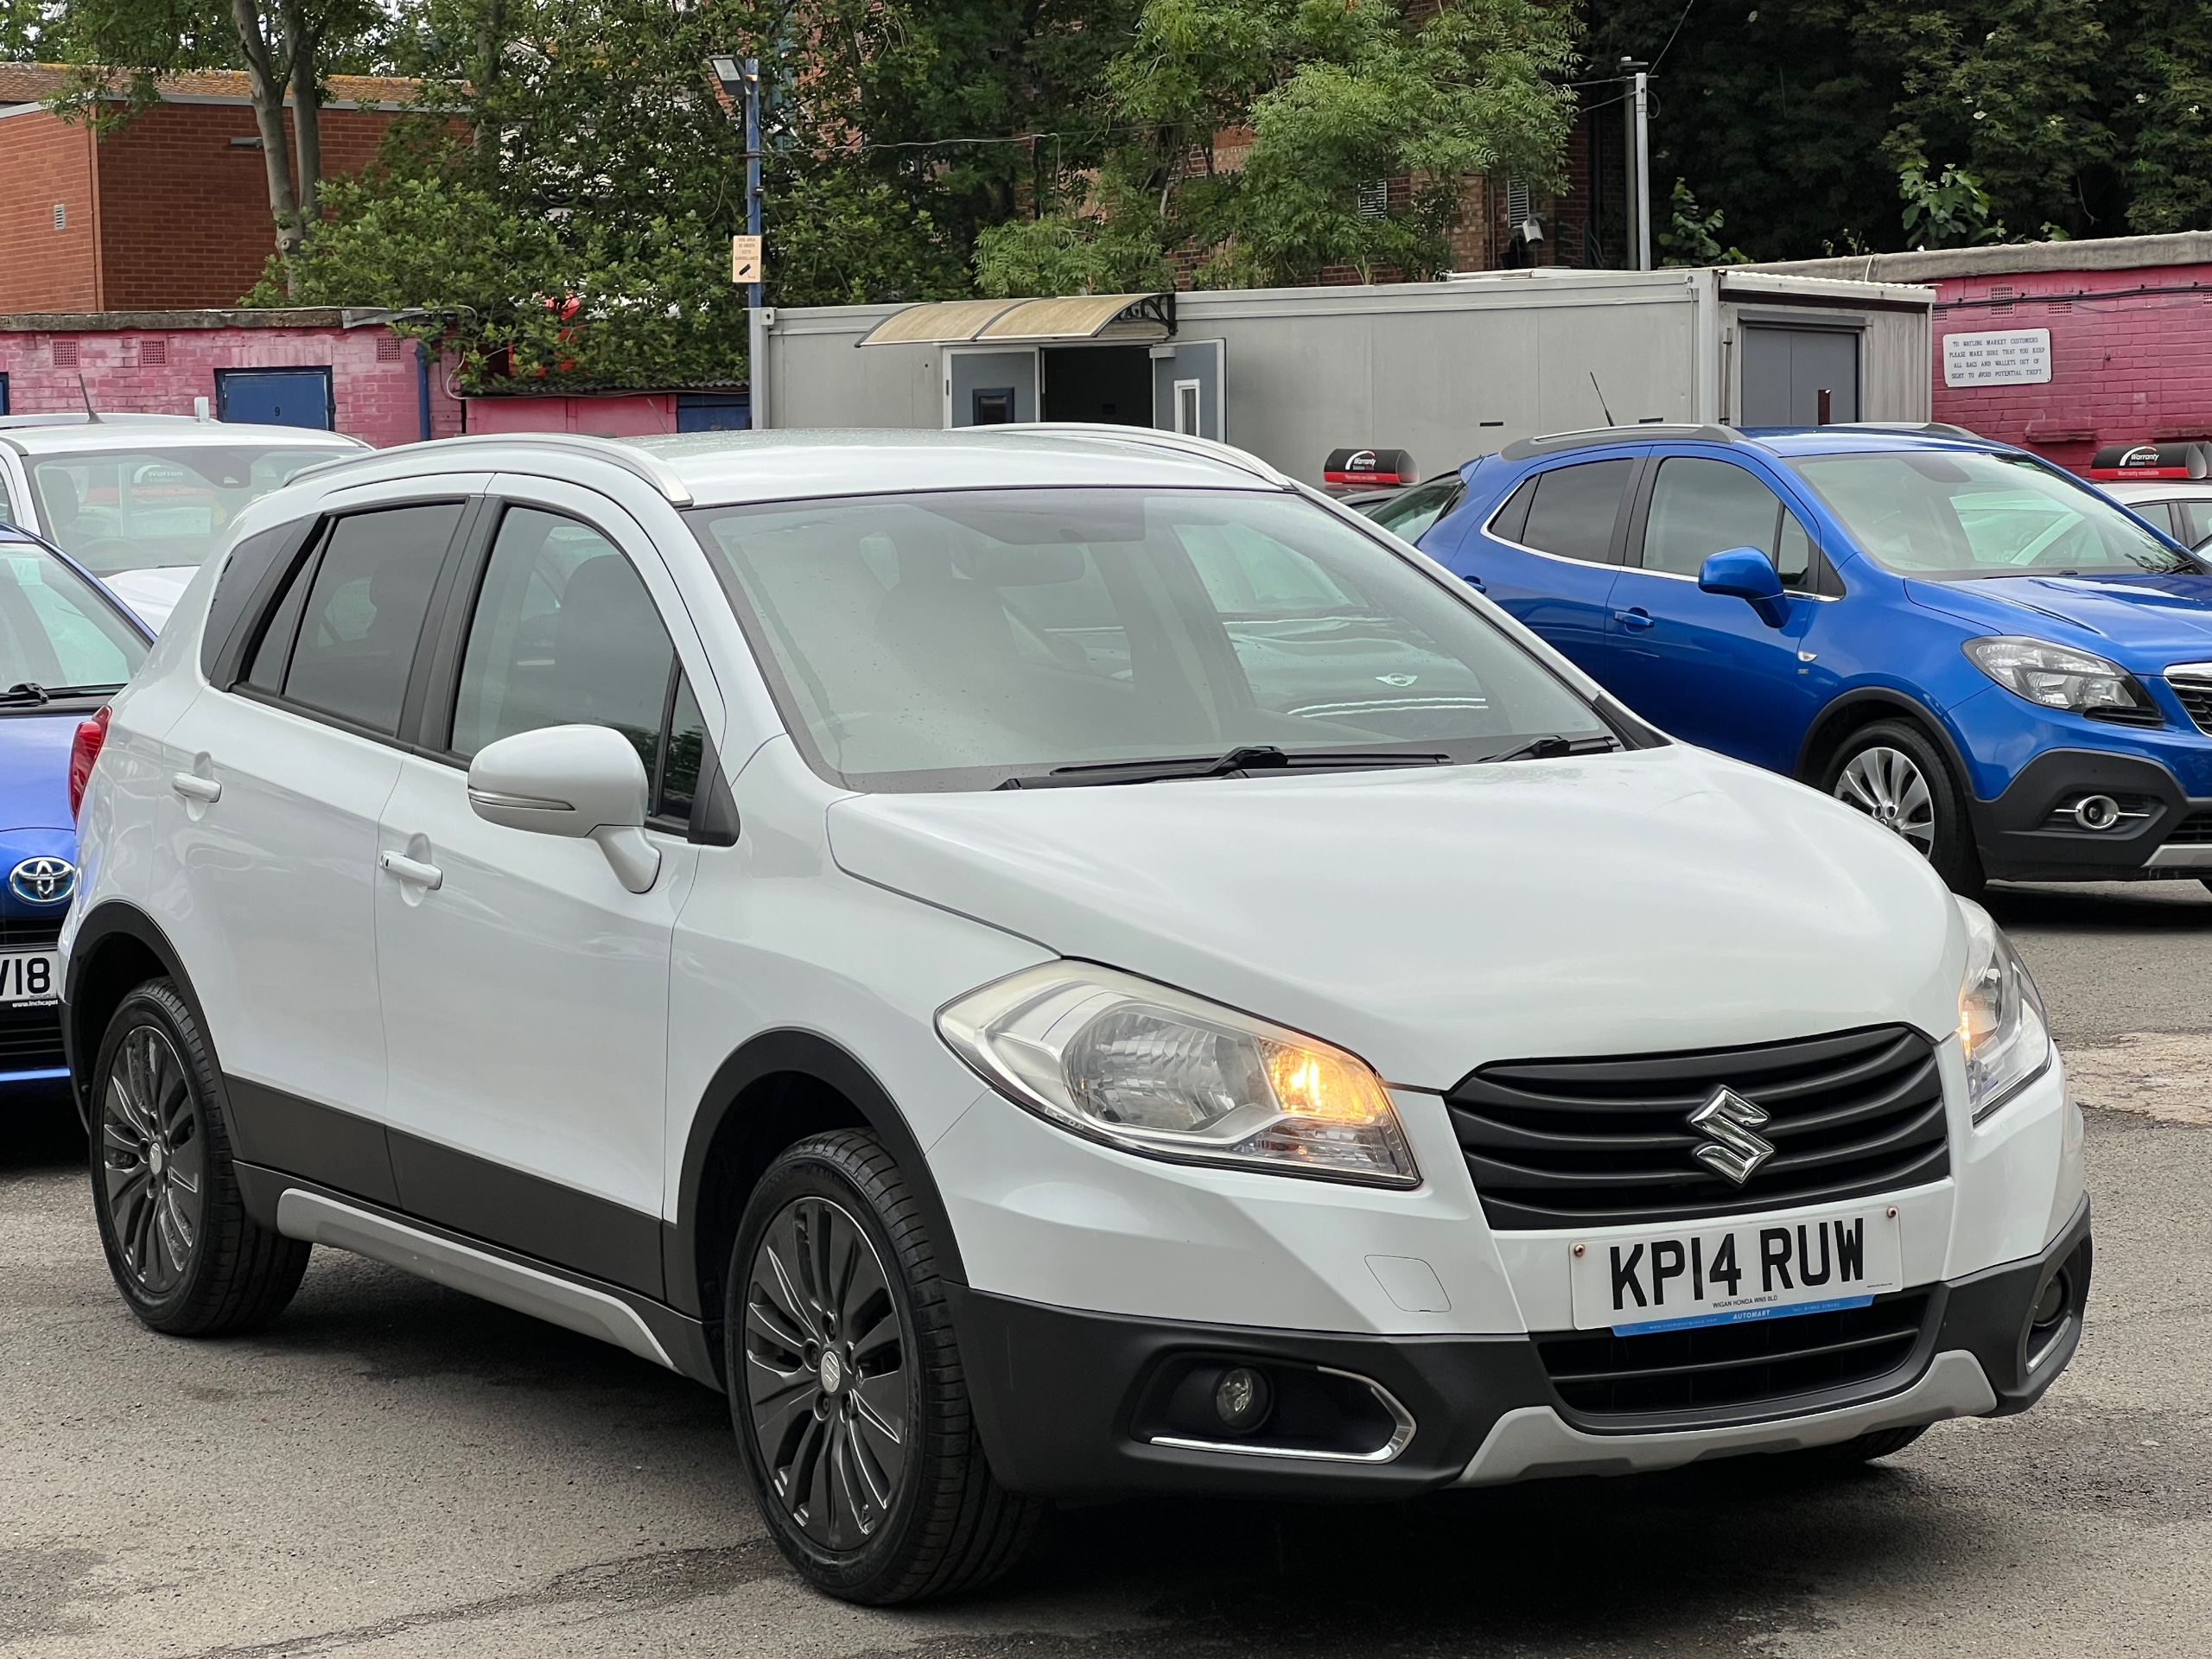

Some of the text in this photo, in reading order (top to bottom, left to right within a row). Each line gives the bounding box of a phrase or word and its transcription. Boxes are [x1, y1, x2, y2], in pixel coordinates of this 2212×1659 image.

[274, 406, 281, 416] 9
[1354, 458, 1376, 467] Warranty
[1610, 1217, 1864, 1310] KP14 RUW
[1732, 1309, 1770, 1320] AUTOMART
